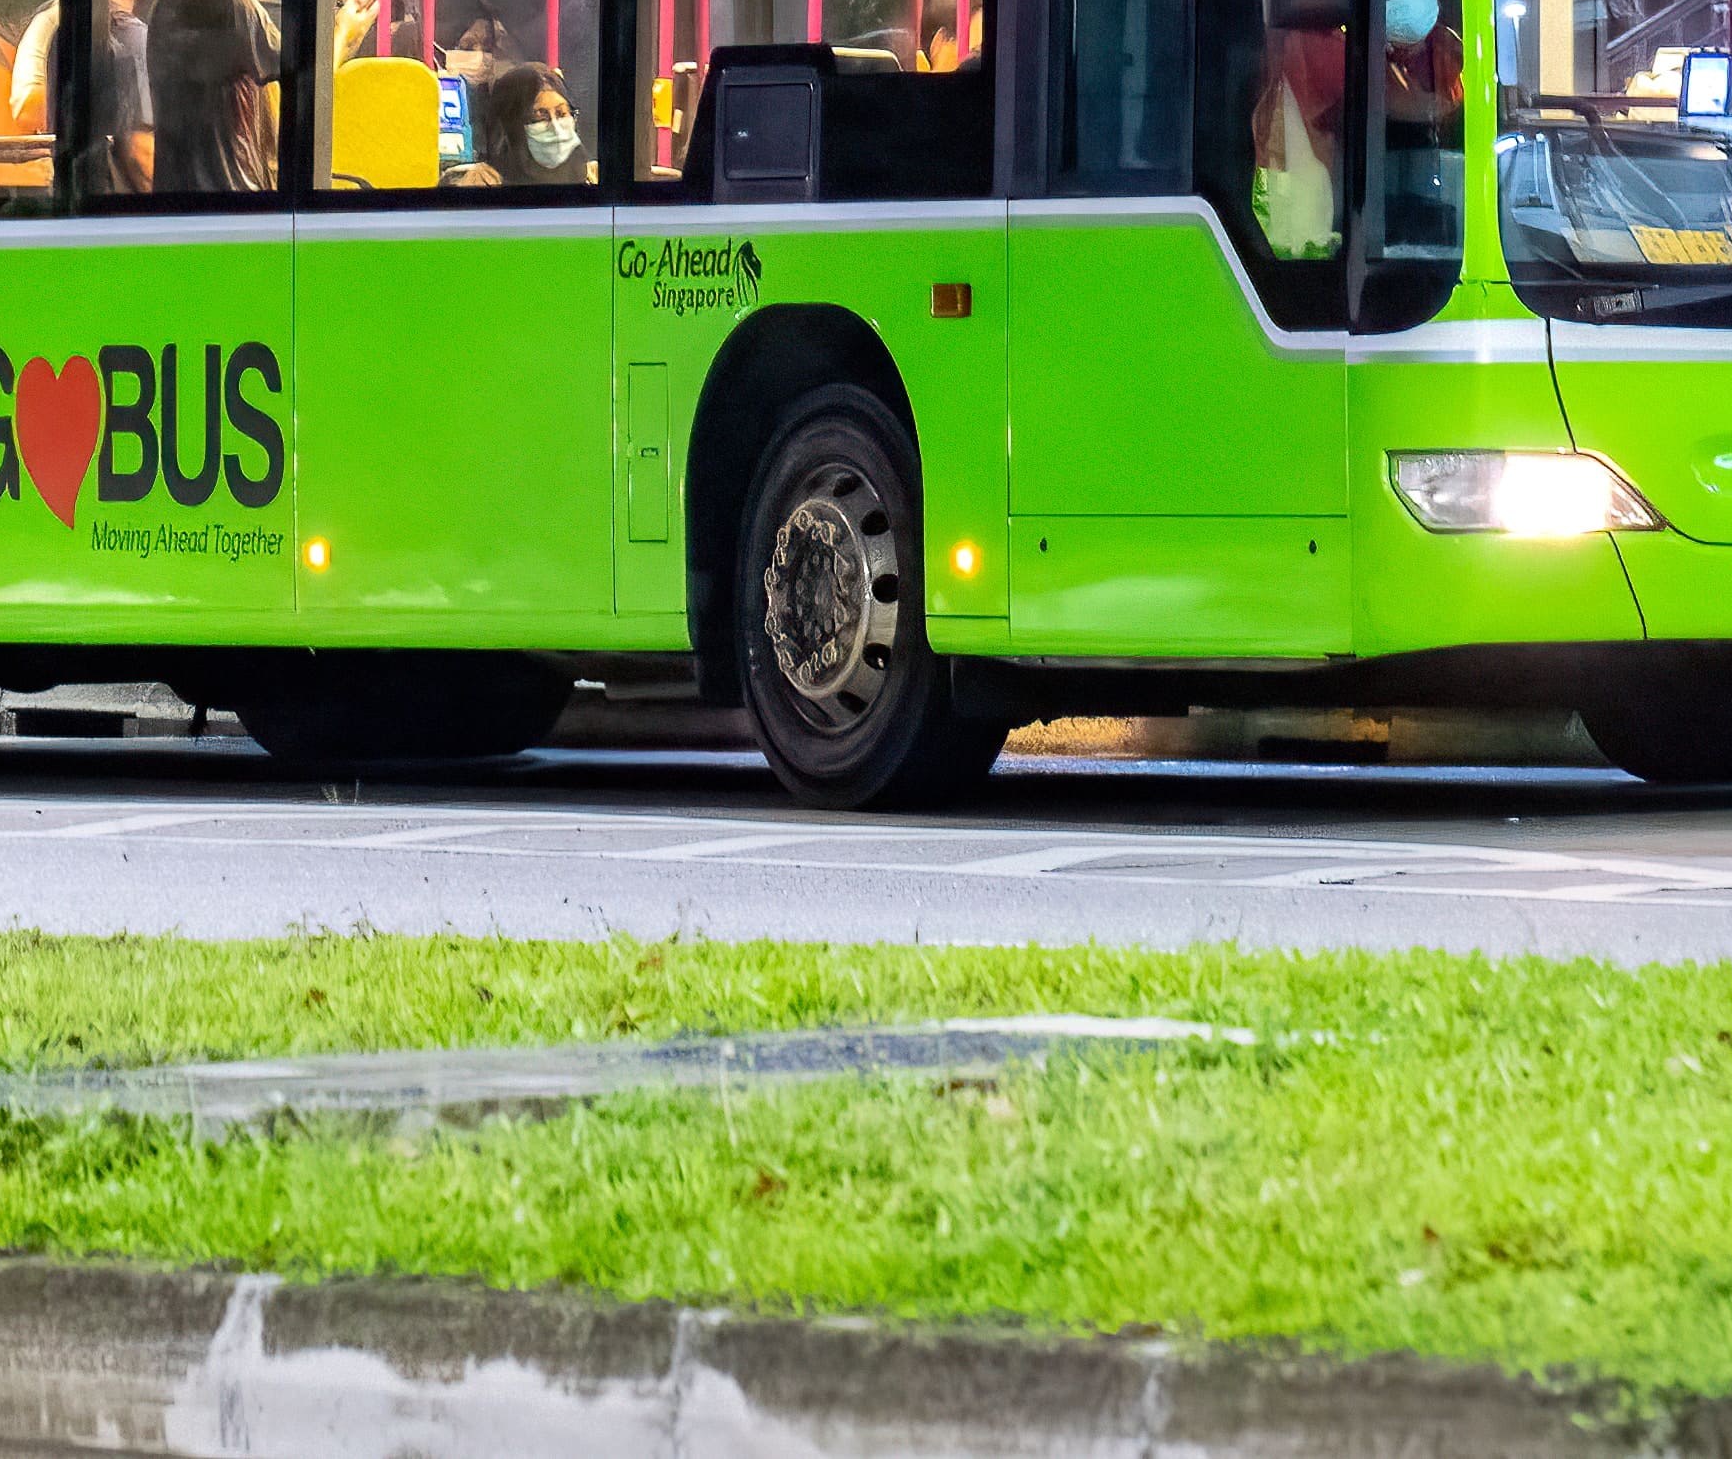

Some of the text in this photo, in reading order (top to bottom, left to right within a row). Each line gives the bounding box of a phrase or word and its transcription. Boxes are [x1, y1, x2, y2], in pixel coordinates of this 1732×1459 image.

[617, 237, 733, 280] Go-Ahead
[651, 280, 736, 318] Singapore
[91, 520, 285, 562] Moving Ahead Together
